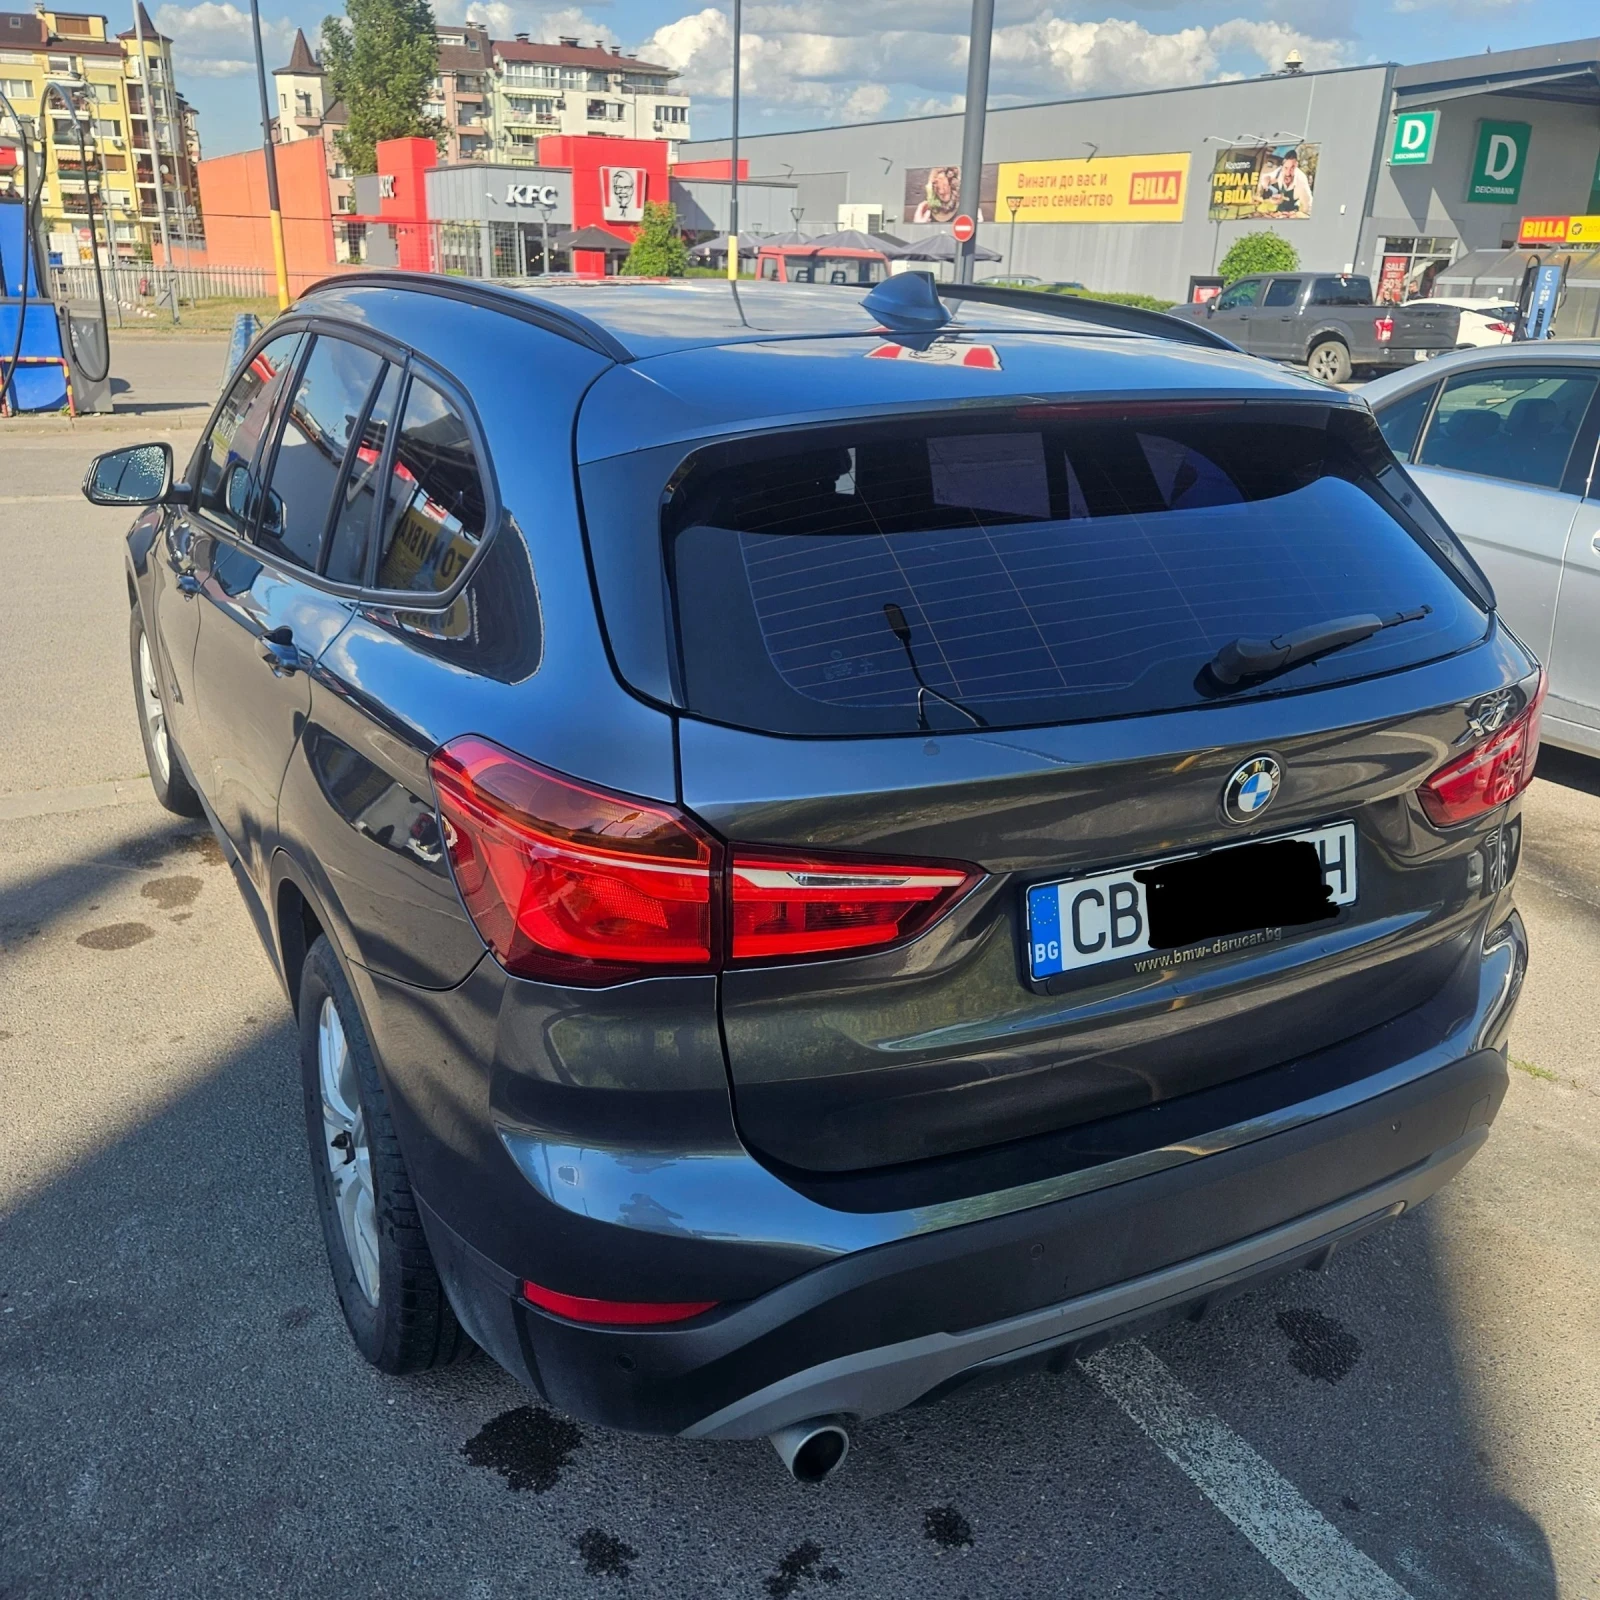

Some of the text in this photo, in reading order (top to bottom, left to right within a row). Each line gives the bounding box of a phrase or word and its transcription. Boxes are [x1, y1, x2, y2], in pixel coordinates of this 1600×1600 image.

[1485, 134, 1517, 180] D
[378, 174, 396, 198] KFC
[1017, 173, 1108, 189] Винаги до вас и
[1133, 176, 1178, 201] BILLA
[1213, 172, 1249, 186] ГРИЛА
[1475, 185, 1514, 195] DEICHMANN
[505, 183, 557, 205] KFC
[1051, 190, 1113, 207] семейство
[1521, 220, 1565, 238] BILLA
[1385, 262, 1406, 272] SALE
[1236, 759, 1279, 786] BMW
[1071, 881, 1143, 955] CB
[1034, 940, 1059, 964] BG
[1134, 926, 1283, 973] www.bmw-darucar.bg
